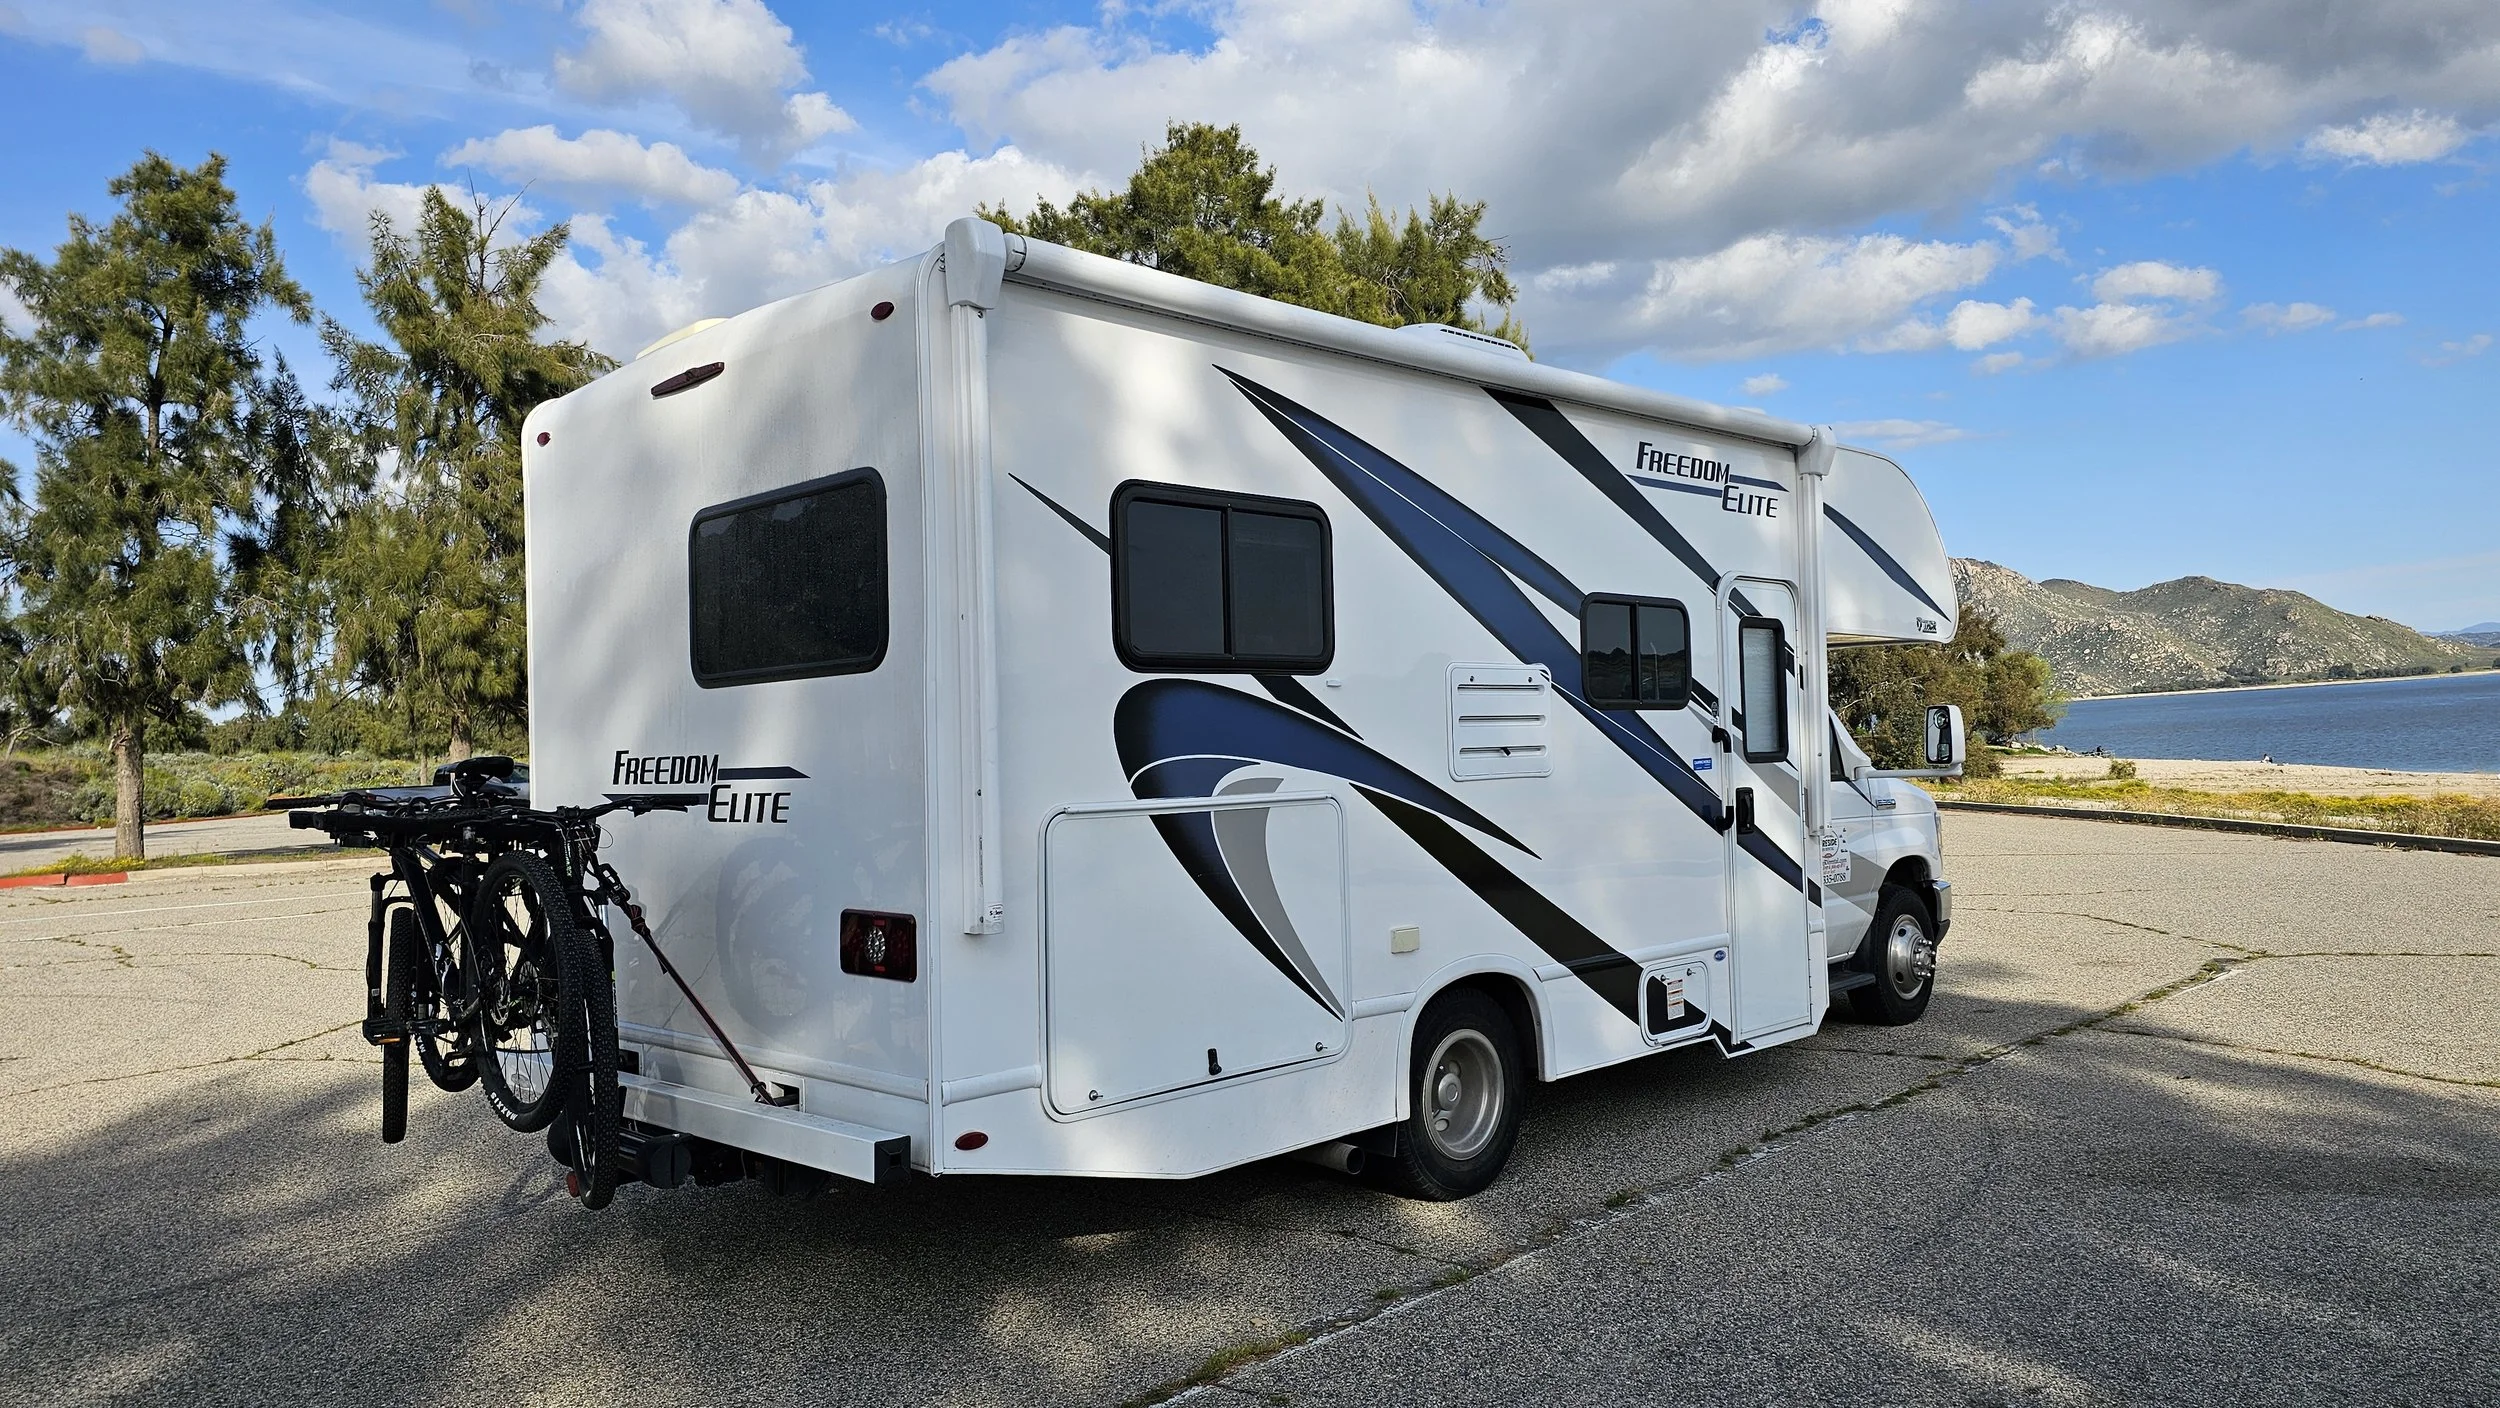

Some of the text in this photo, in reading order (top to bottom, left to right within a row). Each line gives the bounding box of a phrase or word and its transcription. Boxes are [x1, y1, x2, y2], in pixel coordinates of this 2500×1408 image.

[1636, 441, 1730, 485] FREEDOM
[1722, 485, 1778, 518] ELITE
[612, 750, 719, 785] FREEDOM
[708, 784, 791, 823] ELITE
[490, 1091, 518, 1120] MAXXIS
